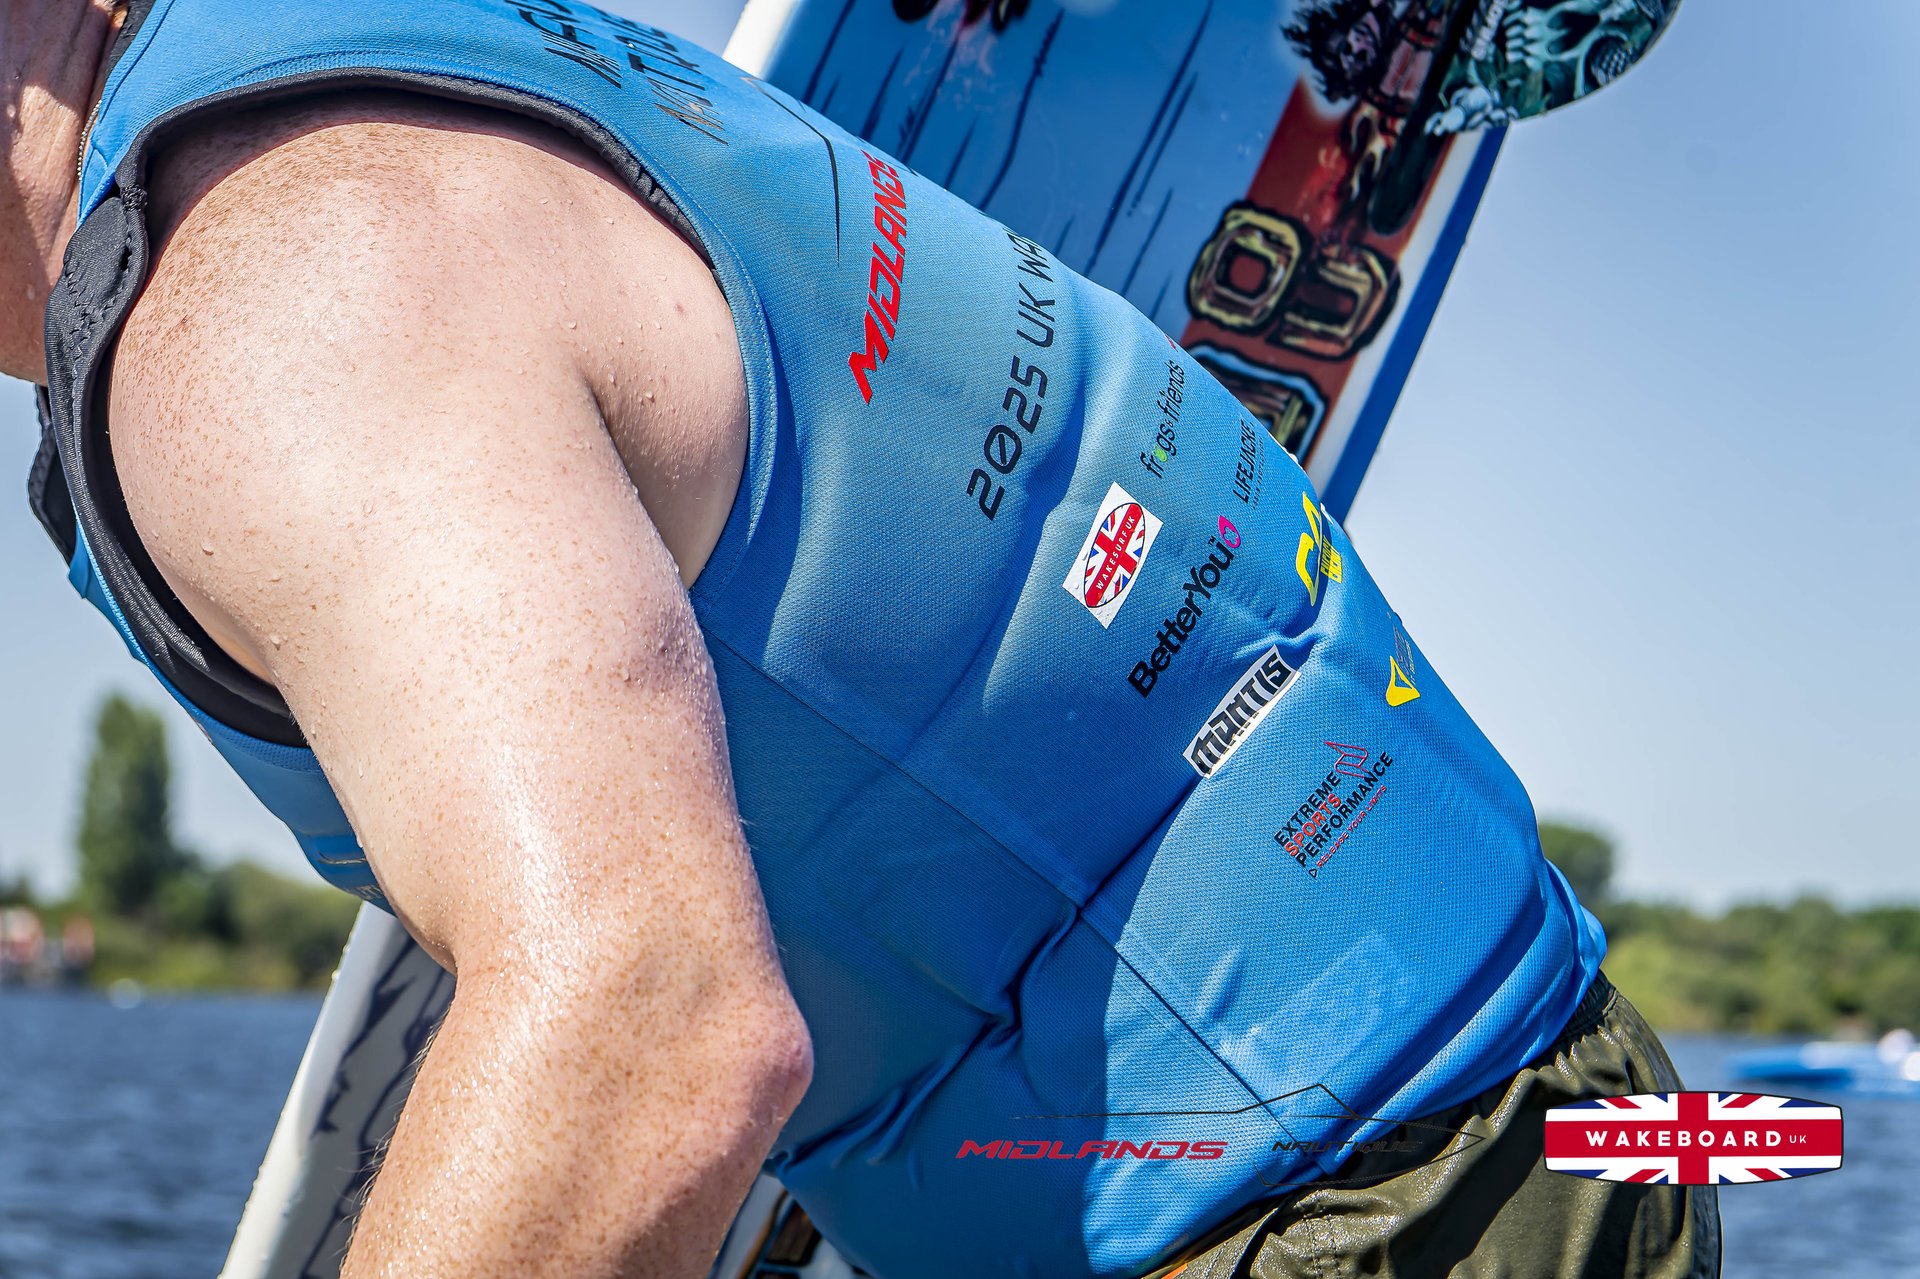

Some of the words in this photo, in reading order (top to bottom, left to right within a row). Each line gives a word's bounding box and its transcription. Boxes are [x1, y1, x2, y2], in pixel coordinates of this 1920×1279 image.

[848, 149, 907, 405] MIDLANDS
[966, 355, 1048, 521] 2025
[1016, 282, 1056, 348] UK
[1095, 530, 1128, 590] WAKESURF
[1126, 515, 1136, 530] UK
[1127, 541, 1235, 699] BetterYou
[1274, 771, 1342, 847] EXTREME
[1284, 793, 1342, 857] SPORTS
[1295, 752, 1394, 868] PERFORMANCE
[1316, 832, 1349, 868] RELEASE
